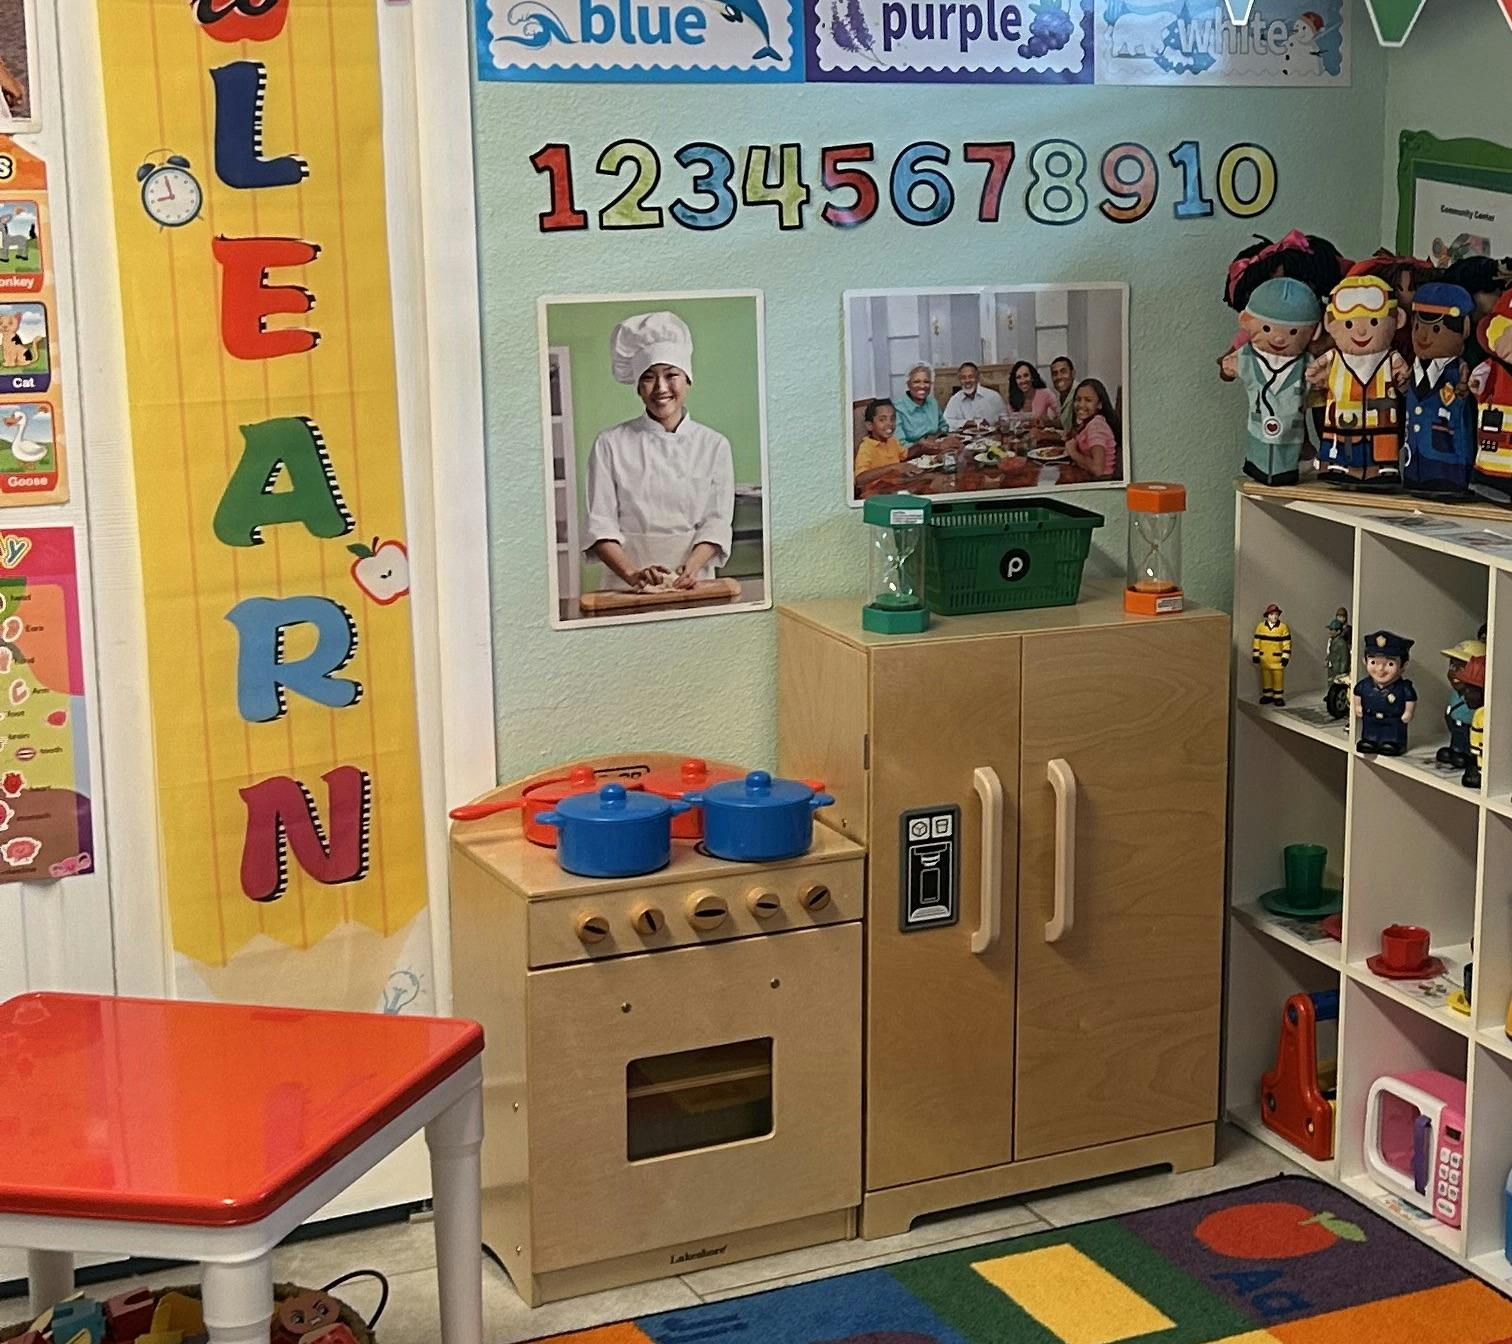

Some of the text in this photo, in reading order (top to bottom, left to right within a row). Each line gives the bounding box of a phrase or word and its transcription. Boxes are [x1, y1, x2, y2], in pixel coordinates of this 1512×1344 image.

[1176, 5, 1288, 56] white
[12, 377, 35, 388] Cat
[8, 477, 48, 487] Goose
[1210, 1265, 1311, 1319] Aa
